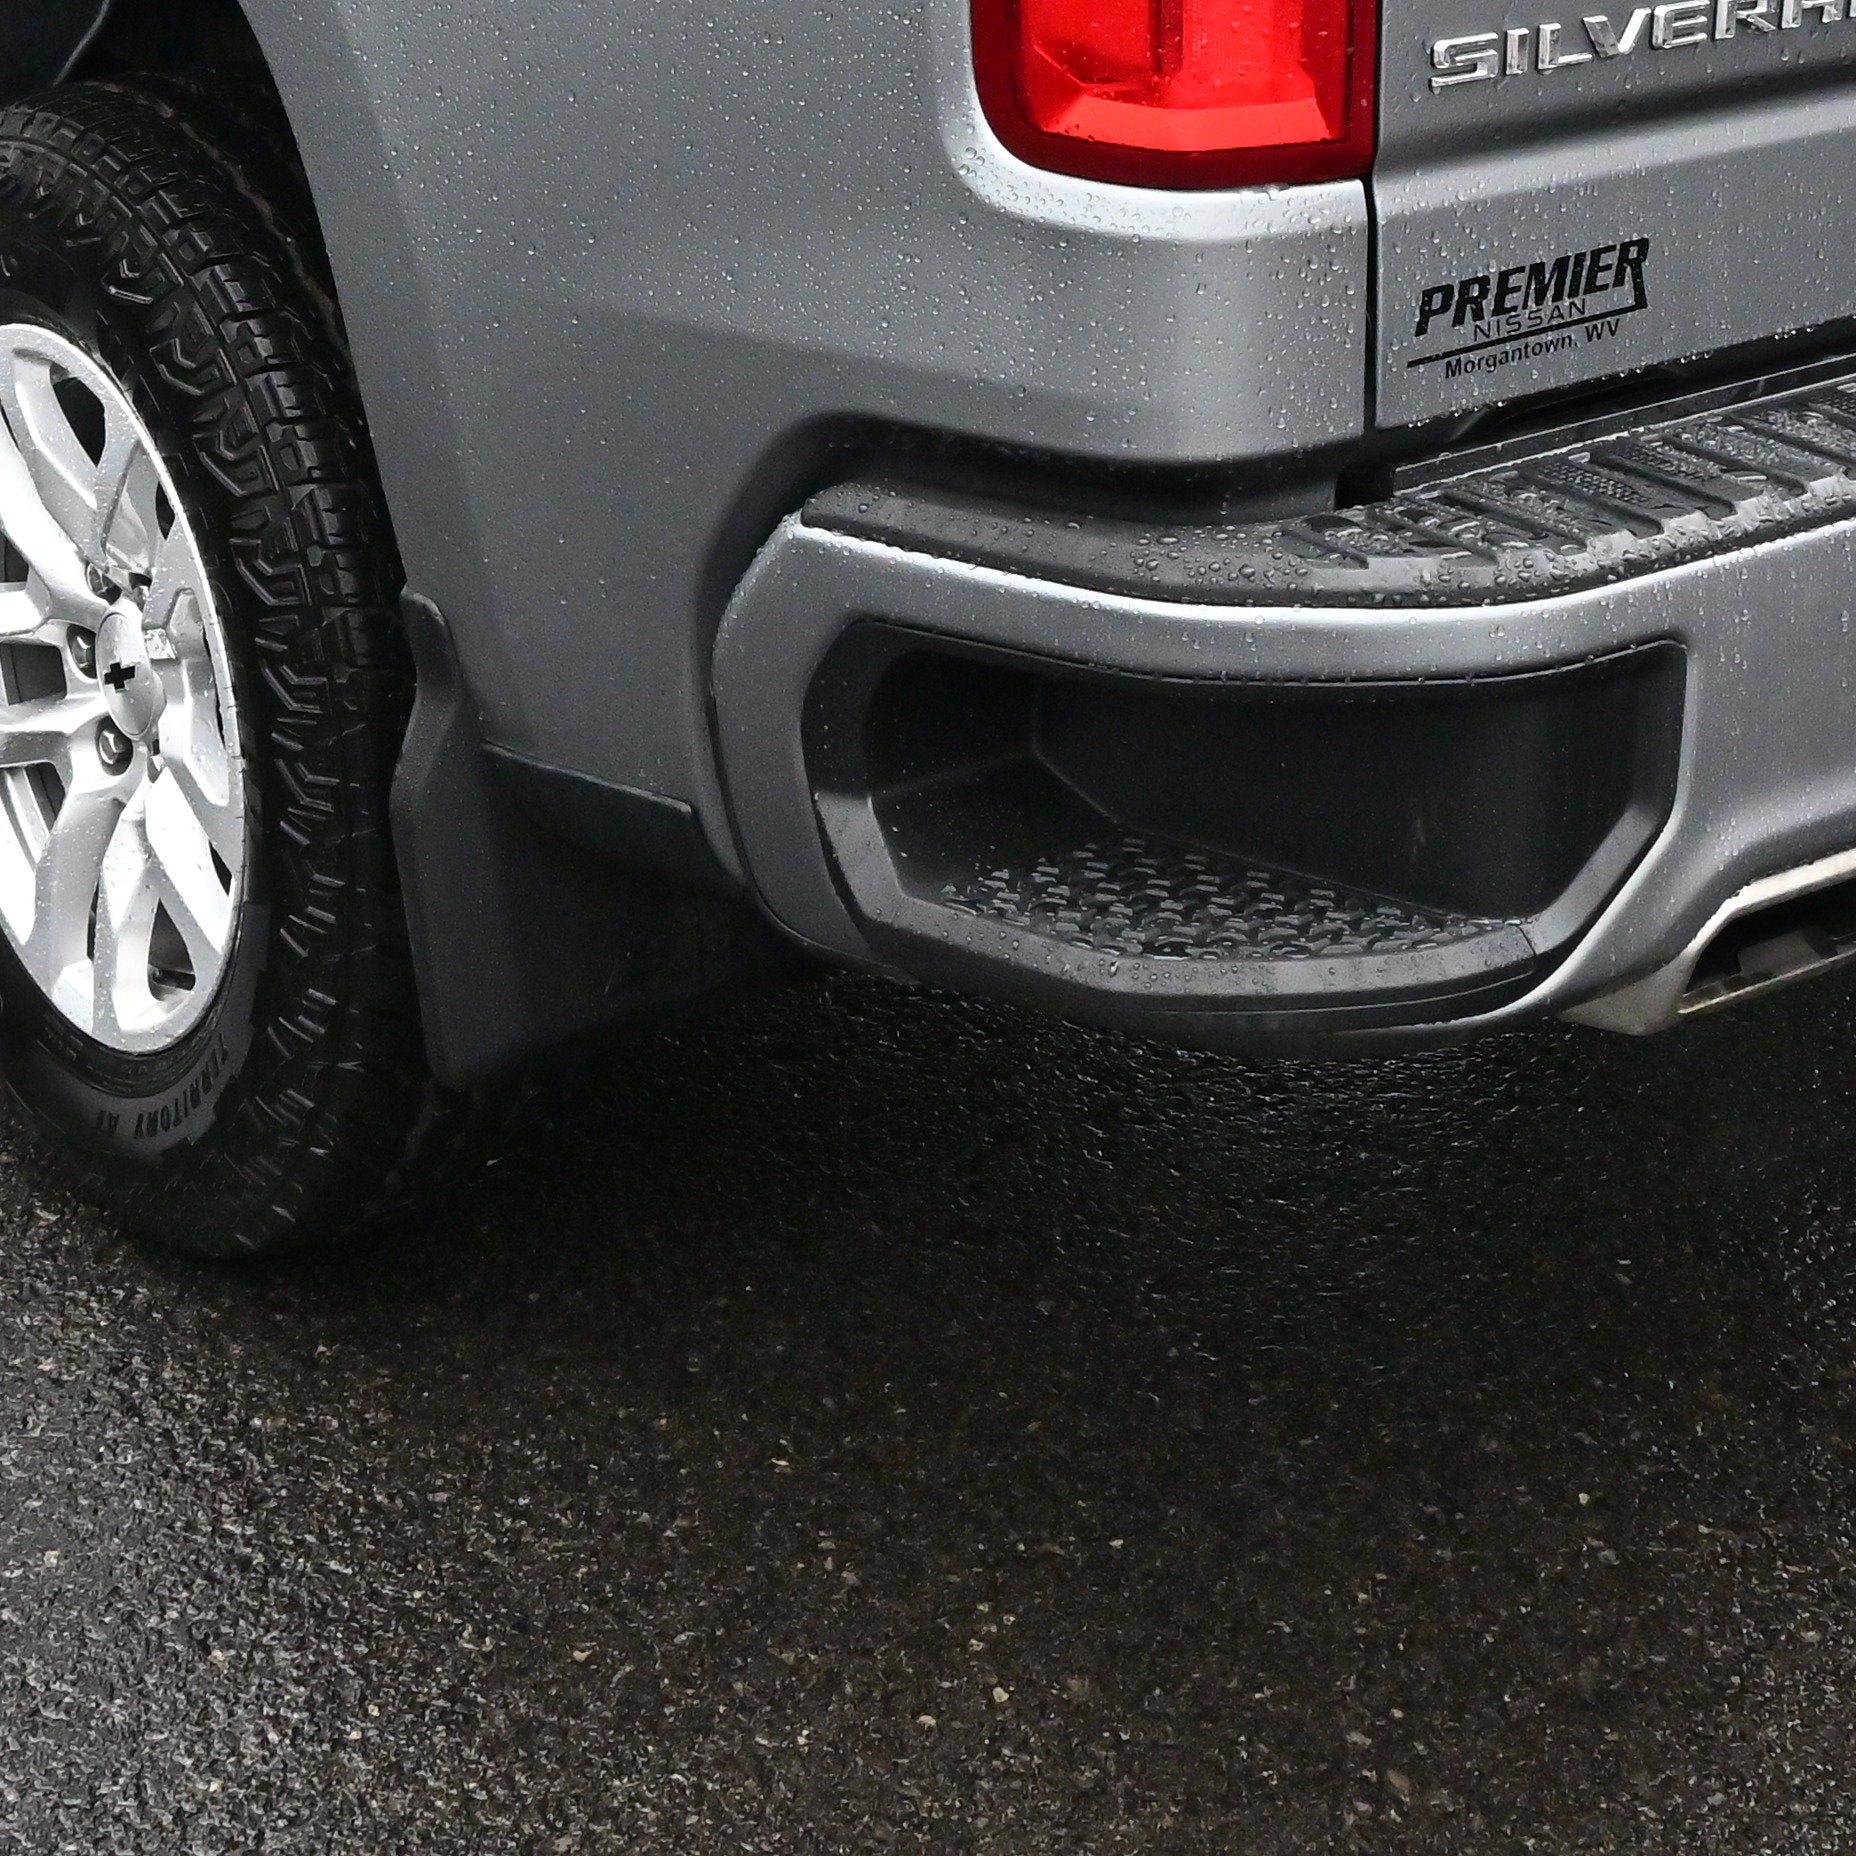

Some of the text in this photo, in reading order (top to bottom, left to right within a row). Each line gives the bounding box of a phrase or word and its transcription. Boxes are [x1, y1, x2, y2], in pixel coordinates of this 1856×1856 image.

[1414, 237, 1650, 338] PREMIER
[1473, 298, 1586, 342] NISSAN
[1585, 318, 1620, 343] WV
